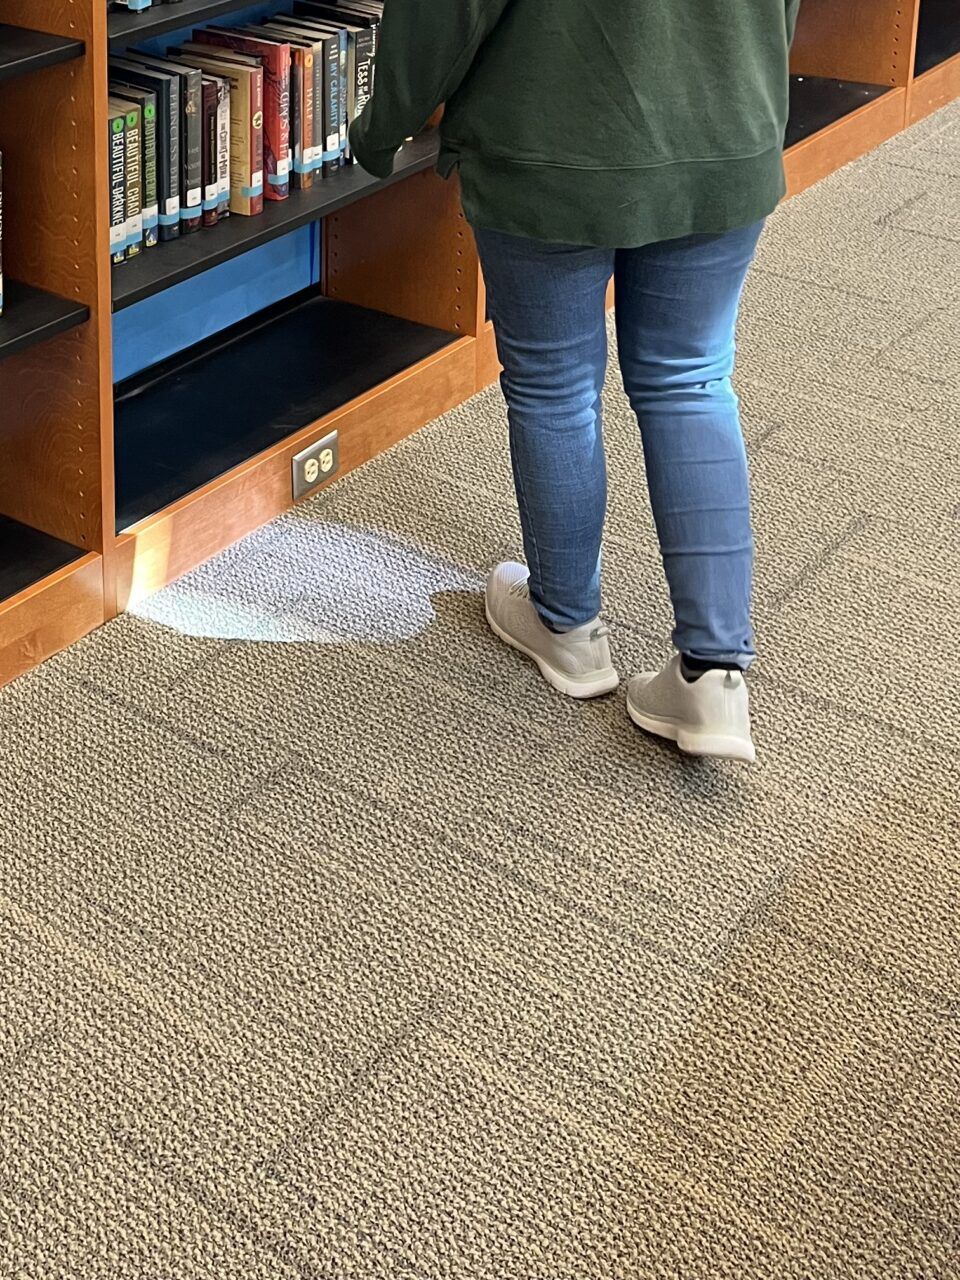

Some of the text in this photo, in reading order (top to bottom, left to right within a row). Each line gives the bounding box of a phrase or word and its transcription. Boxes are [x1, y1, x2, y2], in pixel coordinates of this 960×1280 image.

[330, 62, 338, 128] MY CALAMITY
[357, 59, 371, 86] TESS
[126, 128, 139, 186] BEAUTIFUL
[169, 94, 179, 162] PRINCESS
[112, 132, 124, 186] BEAUTIFUL
